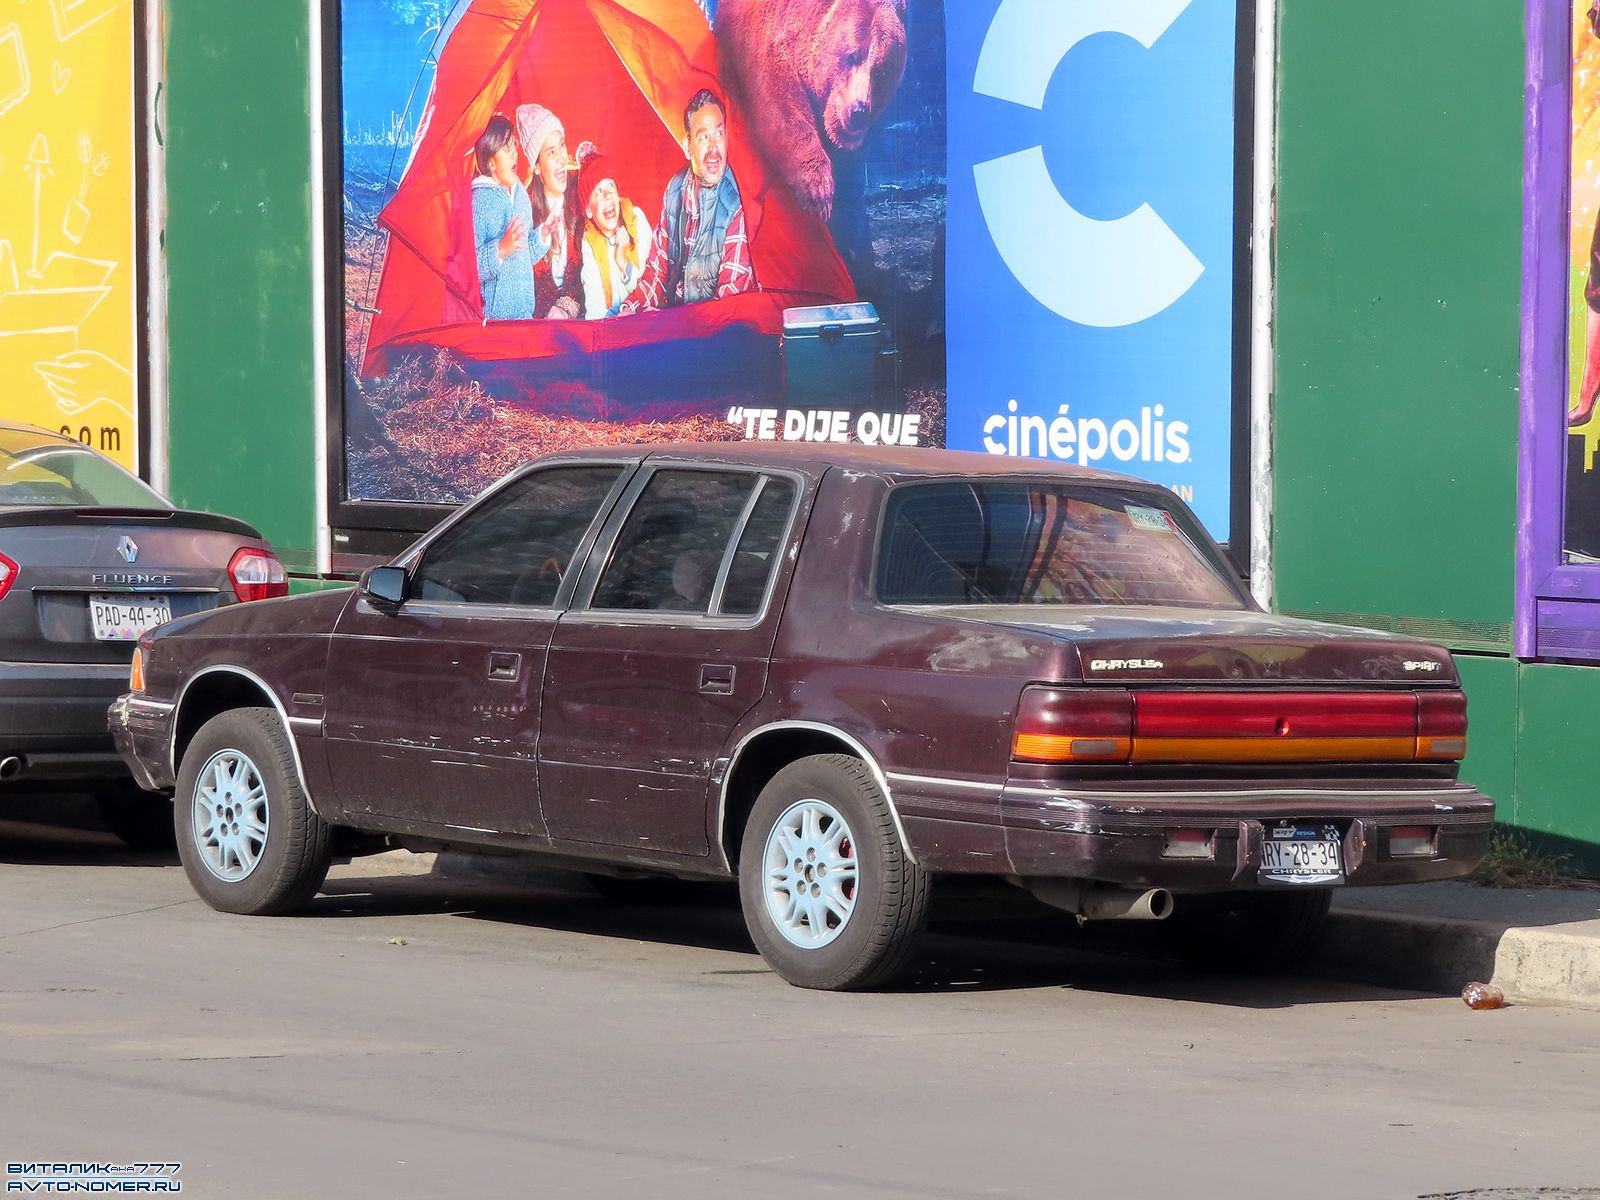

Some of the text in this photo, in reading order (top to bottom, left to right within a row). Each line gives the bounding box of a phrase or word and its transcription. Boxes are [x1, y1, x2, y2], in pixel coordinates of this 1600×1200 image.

[783, 409, 851, 442] DIJE
[857, 411, 921, 445] QUE
[983, 399, 1191, 466] cinépolis
[92, 574, 173, 584] FLUENCE
[95, 606, 170, 626] PAD-44-30
